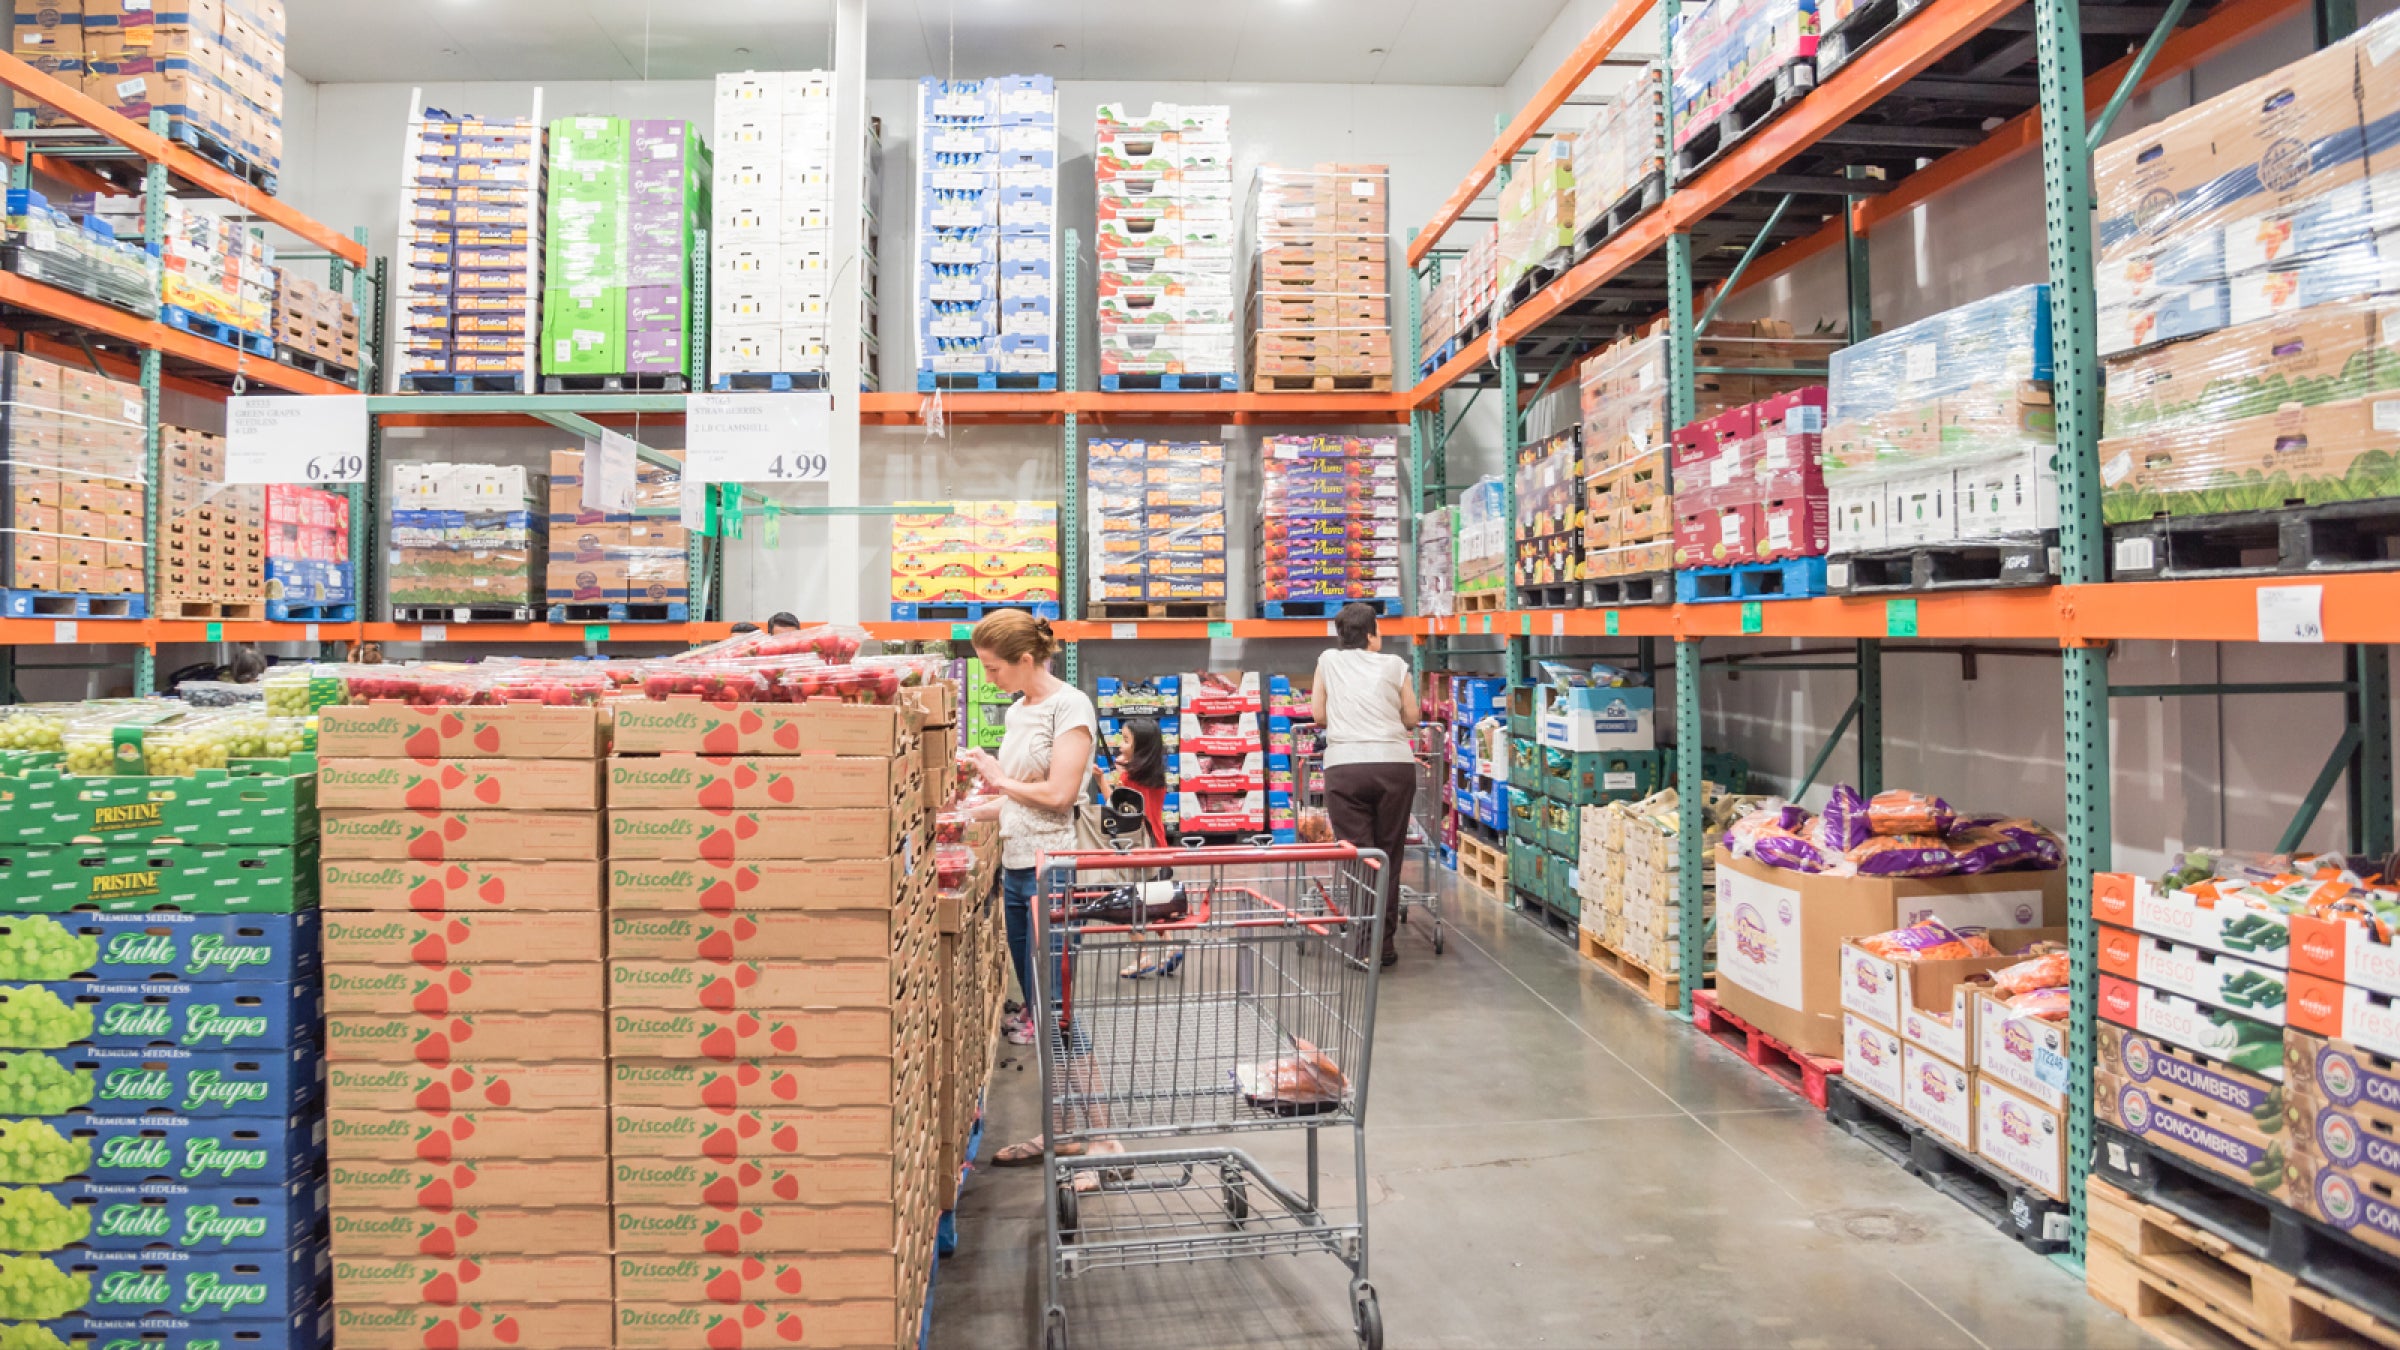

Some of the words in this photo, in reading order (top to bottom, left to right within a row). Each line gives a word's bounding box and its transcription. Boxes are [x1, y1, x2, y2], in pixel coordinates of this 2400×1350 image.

[1312, 437, 1343, 452] Plums
[306, 455, 363, 480] 6.49
[768, 454, 827, 478] 4.99
[1312, 458, 1343, 473] Plums
[1313, 478, 1344, 494] Plums
[1314, 519, 1344, 534] Plums
[1314, 540, 1344, 555] Plums
[1314, 560, 1344, 575] Plums
[1171, 584, 1202, 592] GoldCup
[1314, 580, 1344, 595] Plums
[322, 716, 398, 734] Driscoll's
[619, 711, 697, 729] Driscoll's
[322, 767, 398, 785] Driscoll's
[613, 768, 692, 785] Driscoll's
[95, 803, 160, 824] PRISTINE
[326, 818, 402, 836] Driscoll's
[614, 818, 693, 836] Driscoll's
[92, 871, 158, 892] PRISTINE
[326, 867, 403, 885] Driscoll's
[615, 870, 693, 886] Driscoll's
[2140, 896, 2194, 928] fresco
[327, 923, 406, 940] Driscoll's
[613, 918, 692, 936] Driscoll's
[102, 932, 176, 964] Table
[184, 933, 271, 974] Grapes
[614, 966, 693, 984] Driscoll's
[2144, 950, 2194, 982] fresco
[328, 973, 406, 990] Driscoll's
[99, 1002, 172, 1036] Table
[181, 1002, 267, 1044] Grapes
[616, 1016, 694, 1033] Driscoll's
[2144, 1001, 2192, 1034] fresco
[331, 1020, 408, 1038] Driscoll's
[332, 1070, 408, 1088] Driscoll's
[616, 1064, 694, 1082] Driscoll's
[99, 1068, 173, 1100] Table
[181, 1069, 268, 1109] Grapes
[2157, 1059, 2250, 1107] CUCUMBERS
[332, 1119, 410, 1136] Driscoll's
[616, 1116, 695, 1134] Driscoll's
[2154, 1112, 2248, 1163] CONCOMBRES
[97, 1136, 172, 1168] Table
[180, 1136, 267, 1178] Grapes
[334, 1168, 411, 1185] Driscoll's
[617, 1164, 696, 1182] Driscoll's
[96, 1204, 171, 1236] Table
[180, 1205, 267, 1246] Grapes
[335, 1216, 413, 1234] Driscoll's
[618, 1213, 698, 1231] Driscoll's
[336, 1262, 416, 1280] Driscoll's
[620, 1260, 699, 1278] Driscoll's
[96, 1271, 171, 1304] Table
[180, 1272, 267, 1312] Grapes
[339, 1309, 416, 1327] Driscoll's
[621, 1309, 700, 1326] Driscoll's
